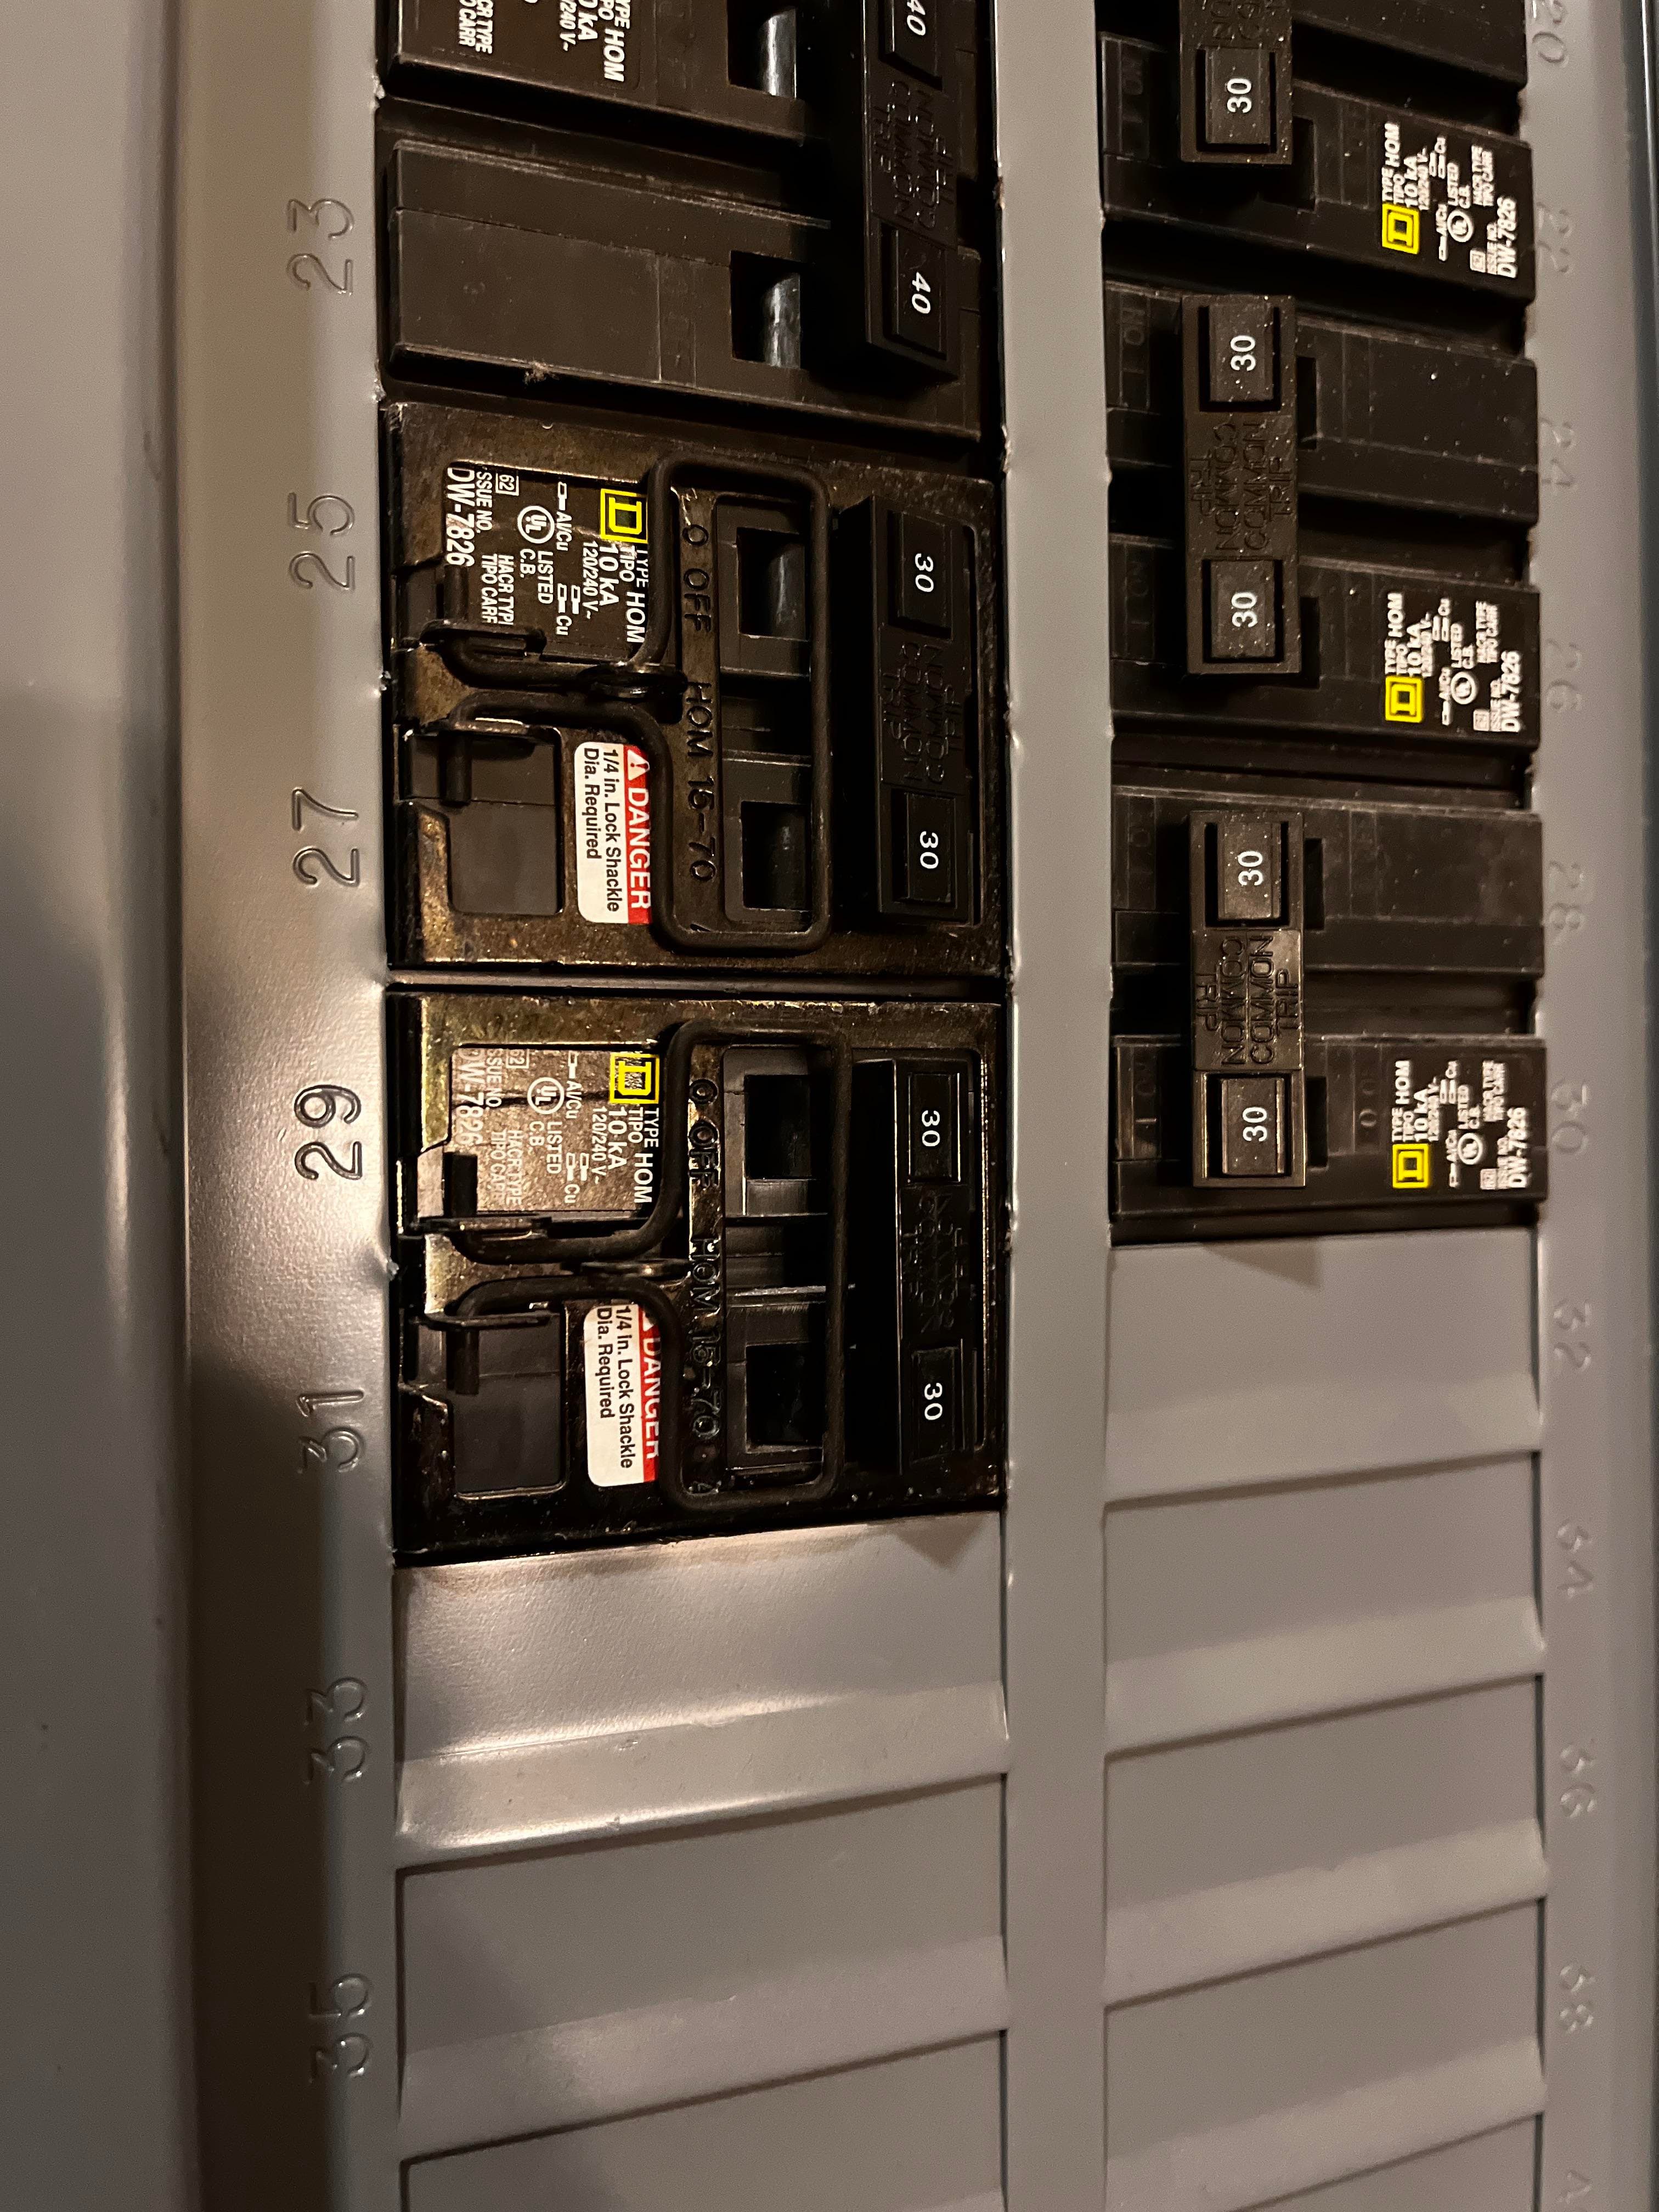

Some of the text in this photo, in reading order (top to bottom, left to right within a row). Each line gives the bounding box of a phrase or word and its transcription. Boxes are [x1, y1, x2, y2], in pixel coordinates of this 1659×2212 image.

[459, 8, 476, 47] CARR
[475, 20, 493, 54] TYPE
[578, 12, 598, 40] kA
[604, 0, 630, 82] YPE HOM
[906, 0, 927, 36] 40
[1227, 78, 1252, 113] 30
[1385, 123, 1400, 167] HOM
[1404, 182, 1417, 207] 10
[286, 198, 355, 297] 23
[1497, 196, 1517, 279] DW-7826
[911, 272, 931, 315] 40
[1230, 335, 1256, 372] 30
[476, 467, 493, 534] SSUE NO.
[499, 474, 515, 491] 62
[287, 493, 355, 589] 25
[445, 467, 475, 567] DW-7826
[482, 554, 498, 584] TIPO
[498, 555, 515, 592] HACR
[520, 549, 536, 578] C.B.
[538, 550, 554, 604] LISTED
[583, 540, 599, 596] 120/240
[599, 544, 619, 606] 10 kA
[619, 545, 635, 582] TIPO
[915, 553, 934, 593] 30
[625, 549, 648, 643] TYPE HOM
[683, 568, 712, 631] OFF
[1231, 591, 1257, 628] 30
[1387, 592, 1403, 637] HOM
[556, 614, 572, 635] Cu
[1407, 651, 1421, 677] 10
[1500, 651, 1521, 733] DW-7826
[686, 682, 714, 757] HOM
[582, 748, 602, 859] Dia. Required
[603, 748, 623, 912] 1/4 in. Lock Shackle
[688, 776, 716, 882] 15-70
[290, 788, 359, 886] 27
[629, 787, 651, 909] DANGER
[919, 830, 939, 870] 30
[1237, 851, 1263, 887] 30
[1220, 936, 1245, 1065] COMMON
[1250, 935, 1274, 1065] COMMON
[1276, 968, 1298, 1036] TRIP
[486, 1087, 502, 1110] NO.
[1395, 1060, 1410, 1104] HOM
[295, 1084, 363, 1181] 29
[528, 1121, 545, 1152] C.B.
[546, 1121, 563, 1174] LISTED
[592, 1107, 608, 1161] 120/240
[607, 1107, 628, 1170] 10 kA
[628, 1107, 644, 1143] TIPO
[921, 1109, 940, 1147] 30
[1242, 1106, 1268, 1142] 30
[1414, 1118, 1428, 1142] 10
[1507, 1107, 1527, 1188] DW-7826
[506, 1130, 523, 1205] HACR TYPE
[634, 1107, 659, 1203] TYPE HOM
[689, 1118, 721, 1188] OFF
[564, 1184, 580, 1203] Cu
[689, 1234, 721, 1316] HOM
[595, 1307, 616, 1419] Dia. Required
[616, 1306, 636, 1469] 1/4 in. Lock Shackle
[644, 1336, 661, 1460] DANGER
[923, 1382, 943, 1421] 30
[295, 1387, 363, 1475] 31
